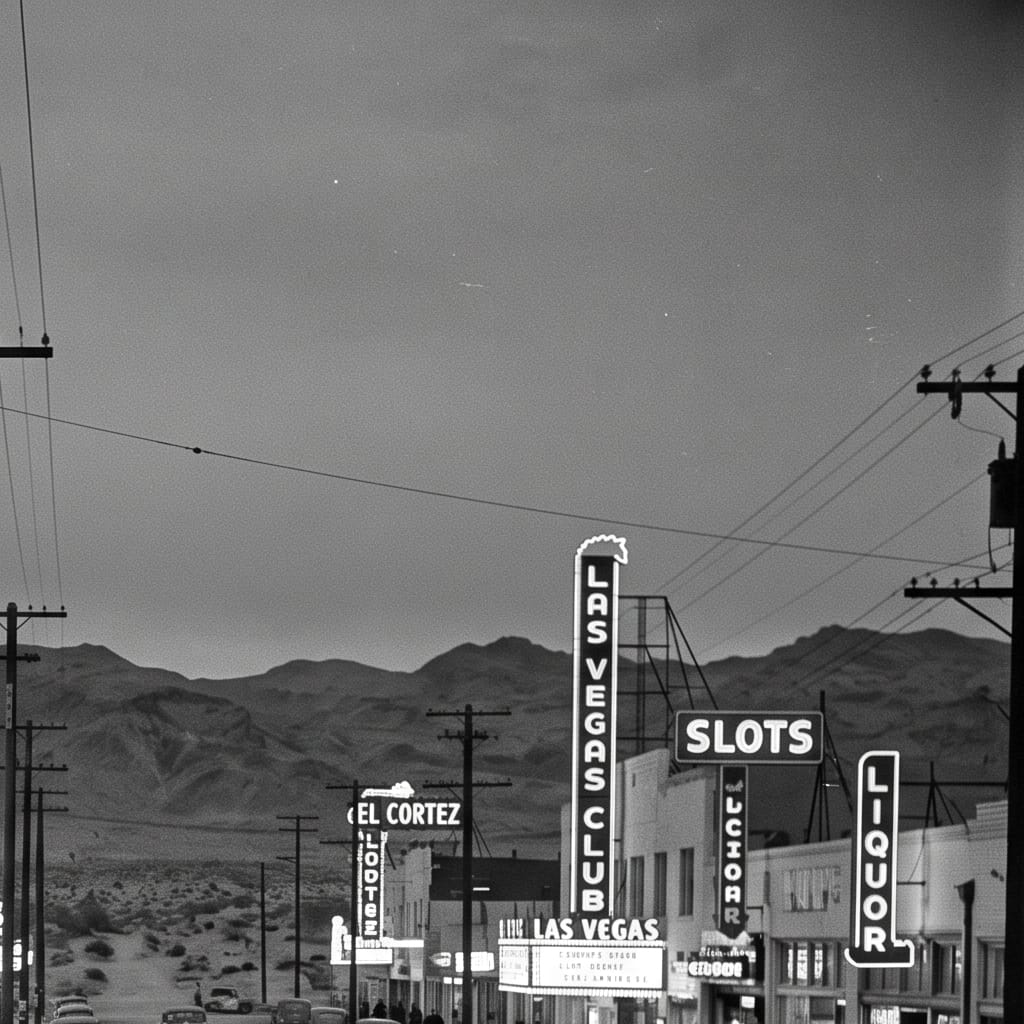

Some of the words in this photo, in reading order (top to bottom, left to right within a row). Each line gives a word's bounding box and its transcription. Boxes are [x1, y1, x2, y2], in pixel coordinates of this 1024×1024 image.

[587, 565, 608, 644] LAS
[584, 658, 608, 791] VEGAS
[686, 718, 814, 754] SLOTS
[357, 802, 380, 825] EL
[386, 802, 461, 825] CORTEZ
[582, 806, 605, 912] CLUB
[862, 766, 889, 952] LIQUOR
[533, 918, 574, 940] LAS
[581, 918, 660, 941] VEGAS
